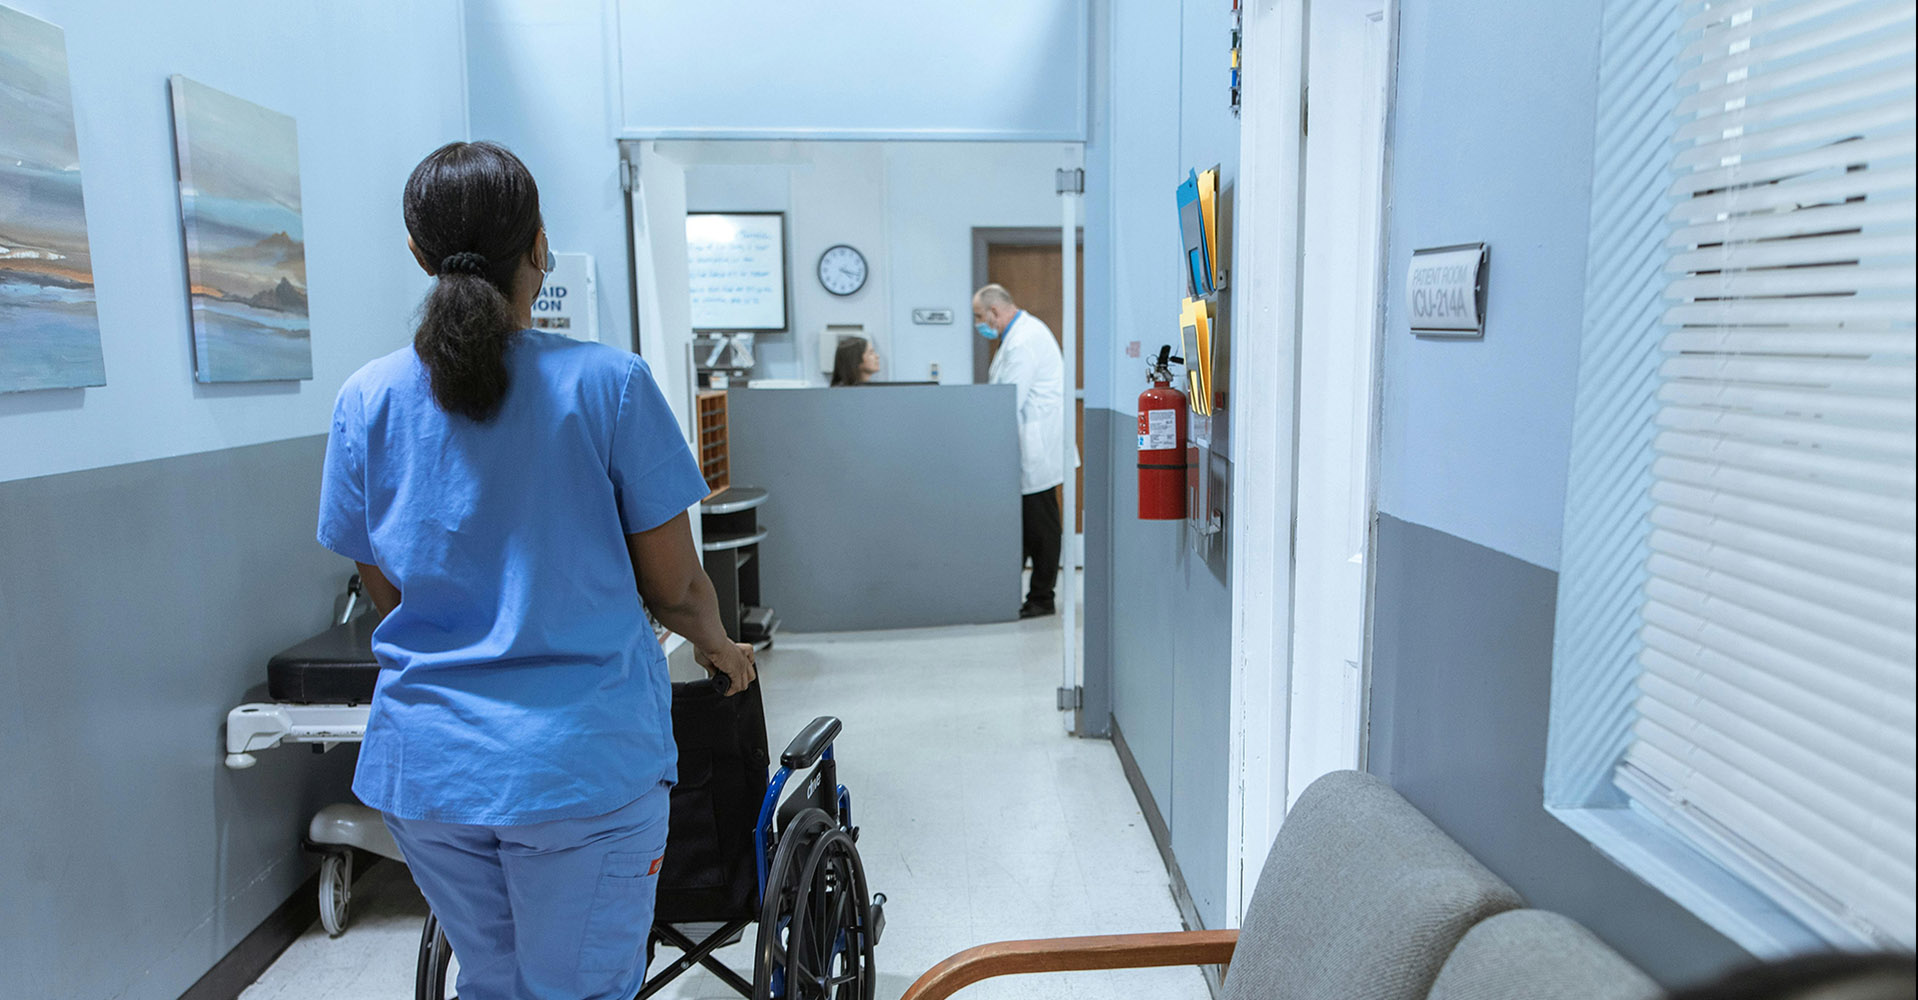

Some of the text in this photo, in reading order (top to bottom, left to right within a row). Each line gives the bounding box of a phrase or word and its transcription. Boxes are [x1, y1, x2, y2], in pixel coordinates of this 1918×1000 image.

[1412, 264, 1468, 286] PATIENT ROOM
[540, 286, 567, 298] AID
[533, 300, 562, 312] ION
[1412, 288, 1467, 318] ICU-214A
